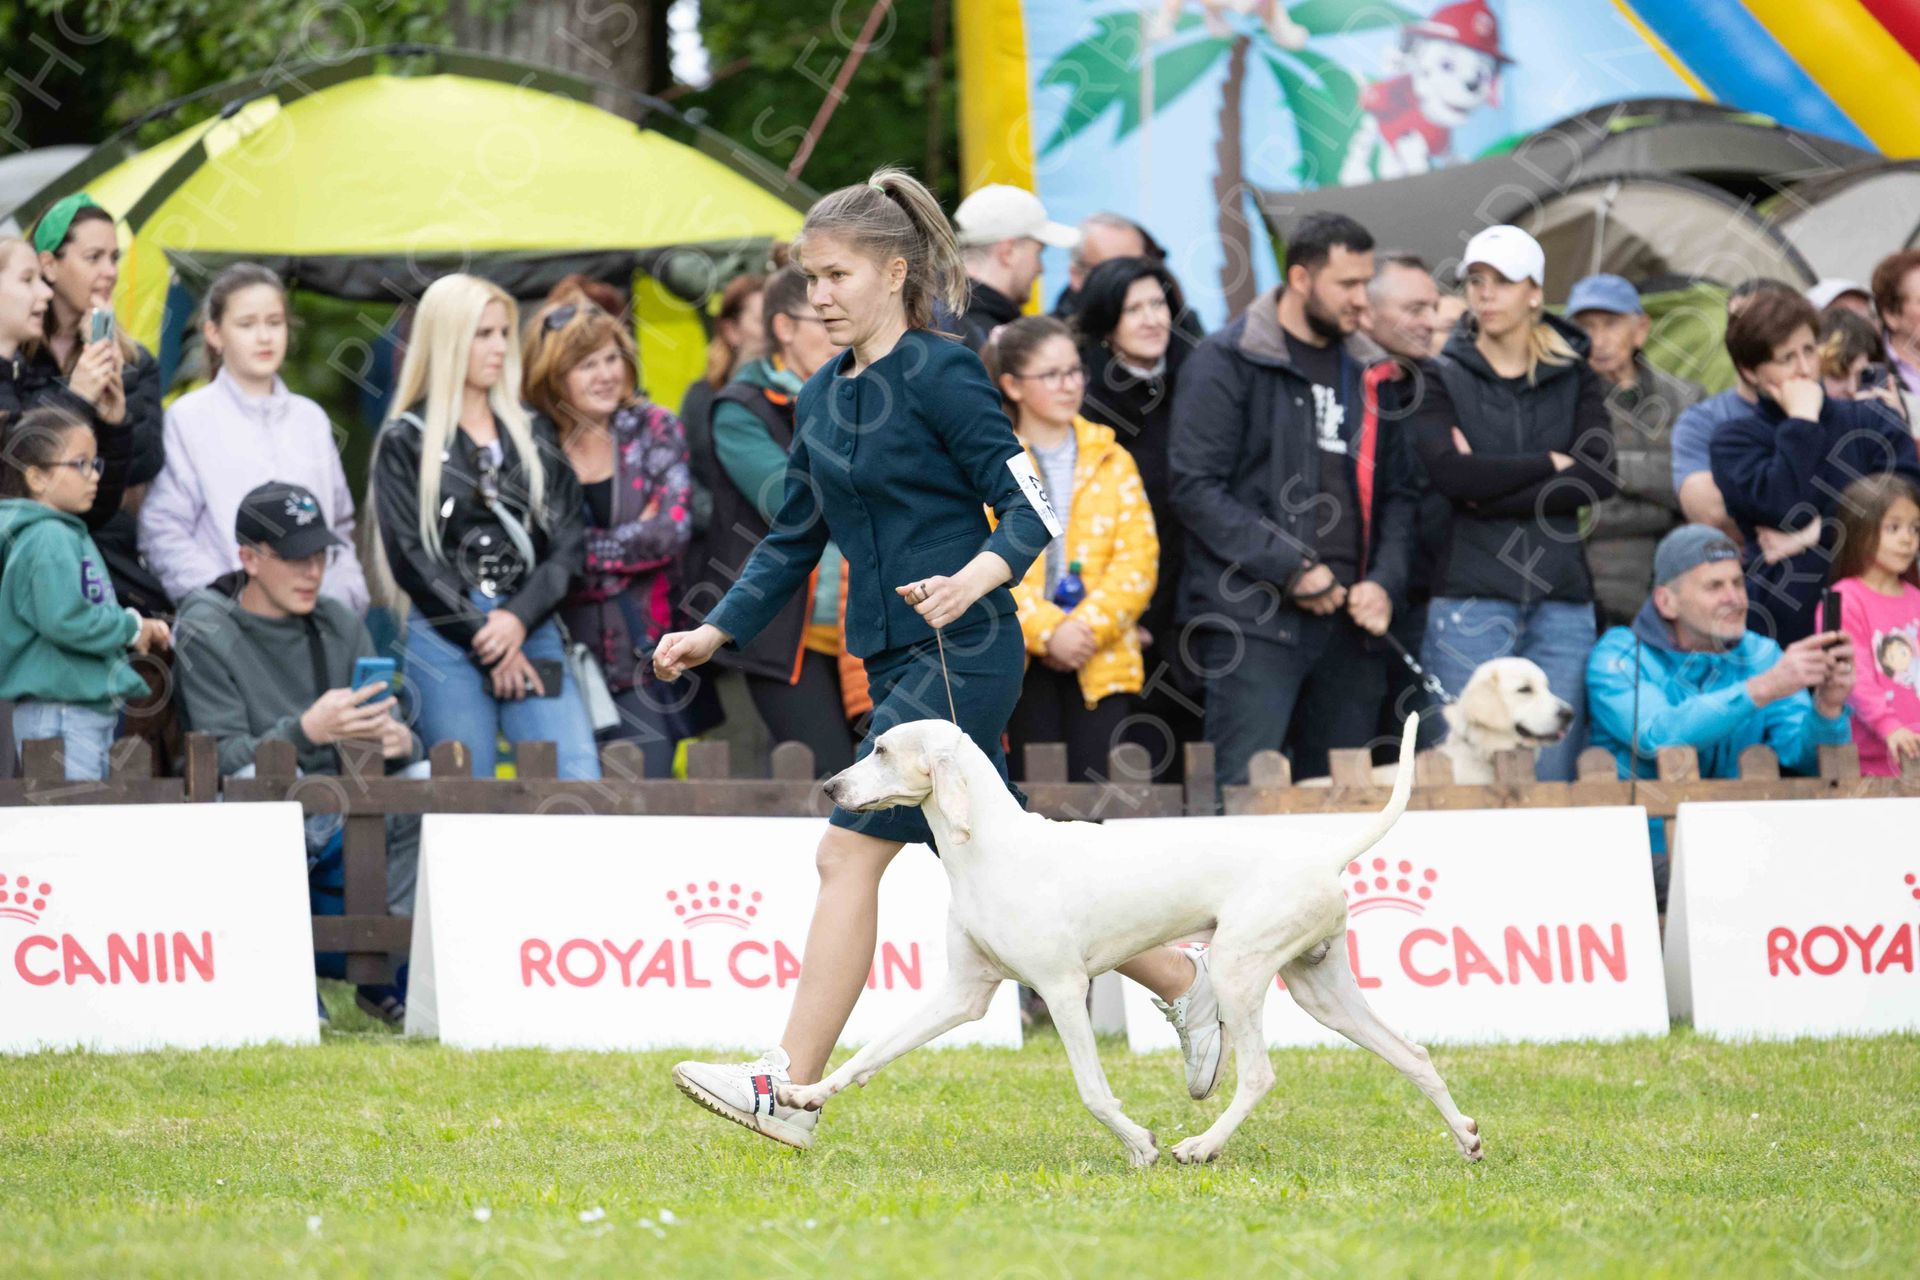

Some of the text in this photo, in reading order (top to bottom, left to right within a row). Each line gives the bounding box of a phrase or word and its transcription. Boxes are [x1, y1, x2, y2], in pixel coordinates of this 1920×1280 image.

[15, 932, 214, 986] CANIN
[520, 939, 921, 989] ROYAL CAN
[1400, 924, 1626, 986] CANIN
[1767, 923, 1920, 976] ROYA
